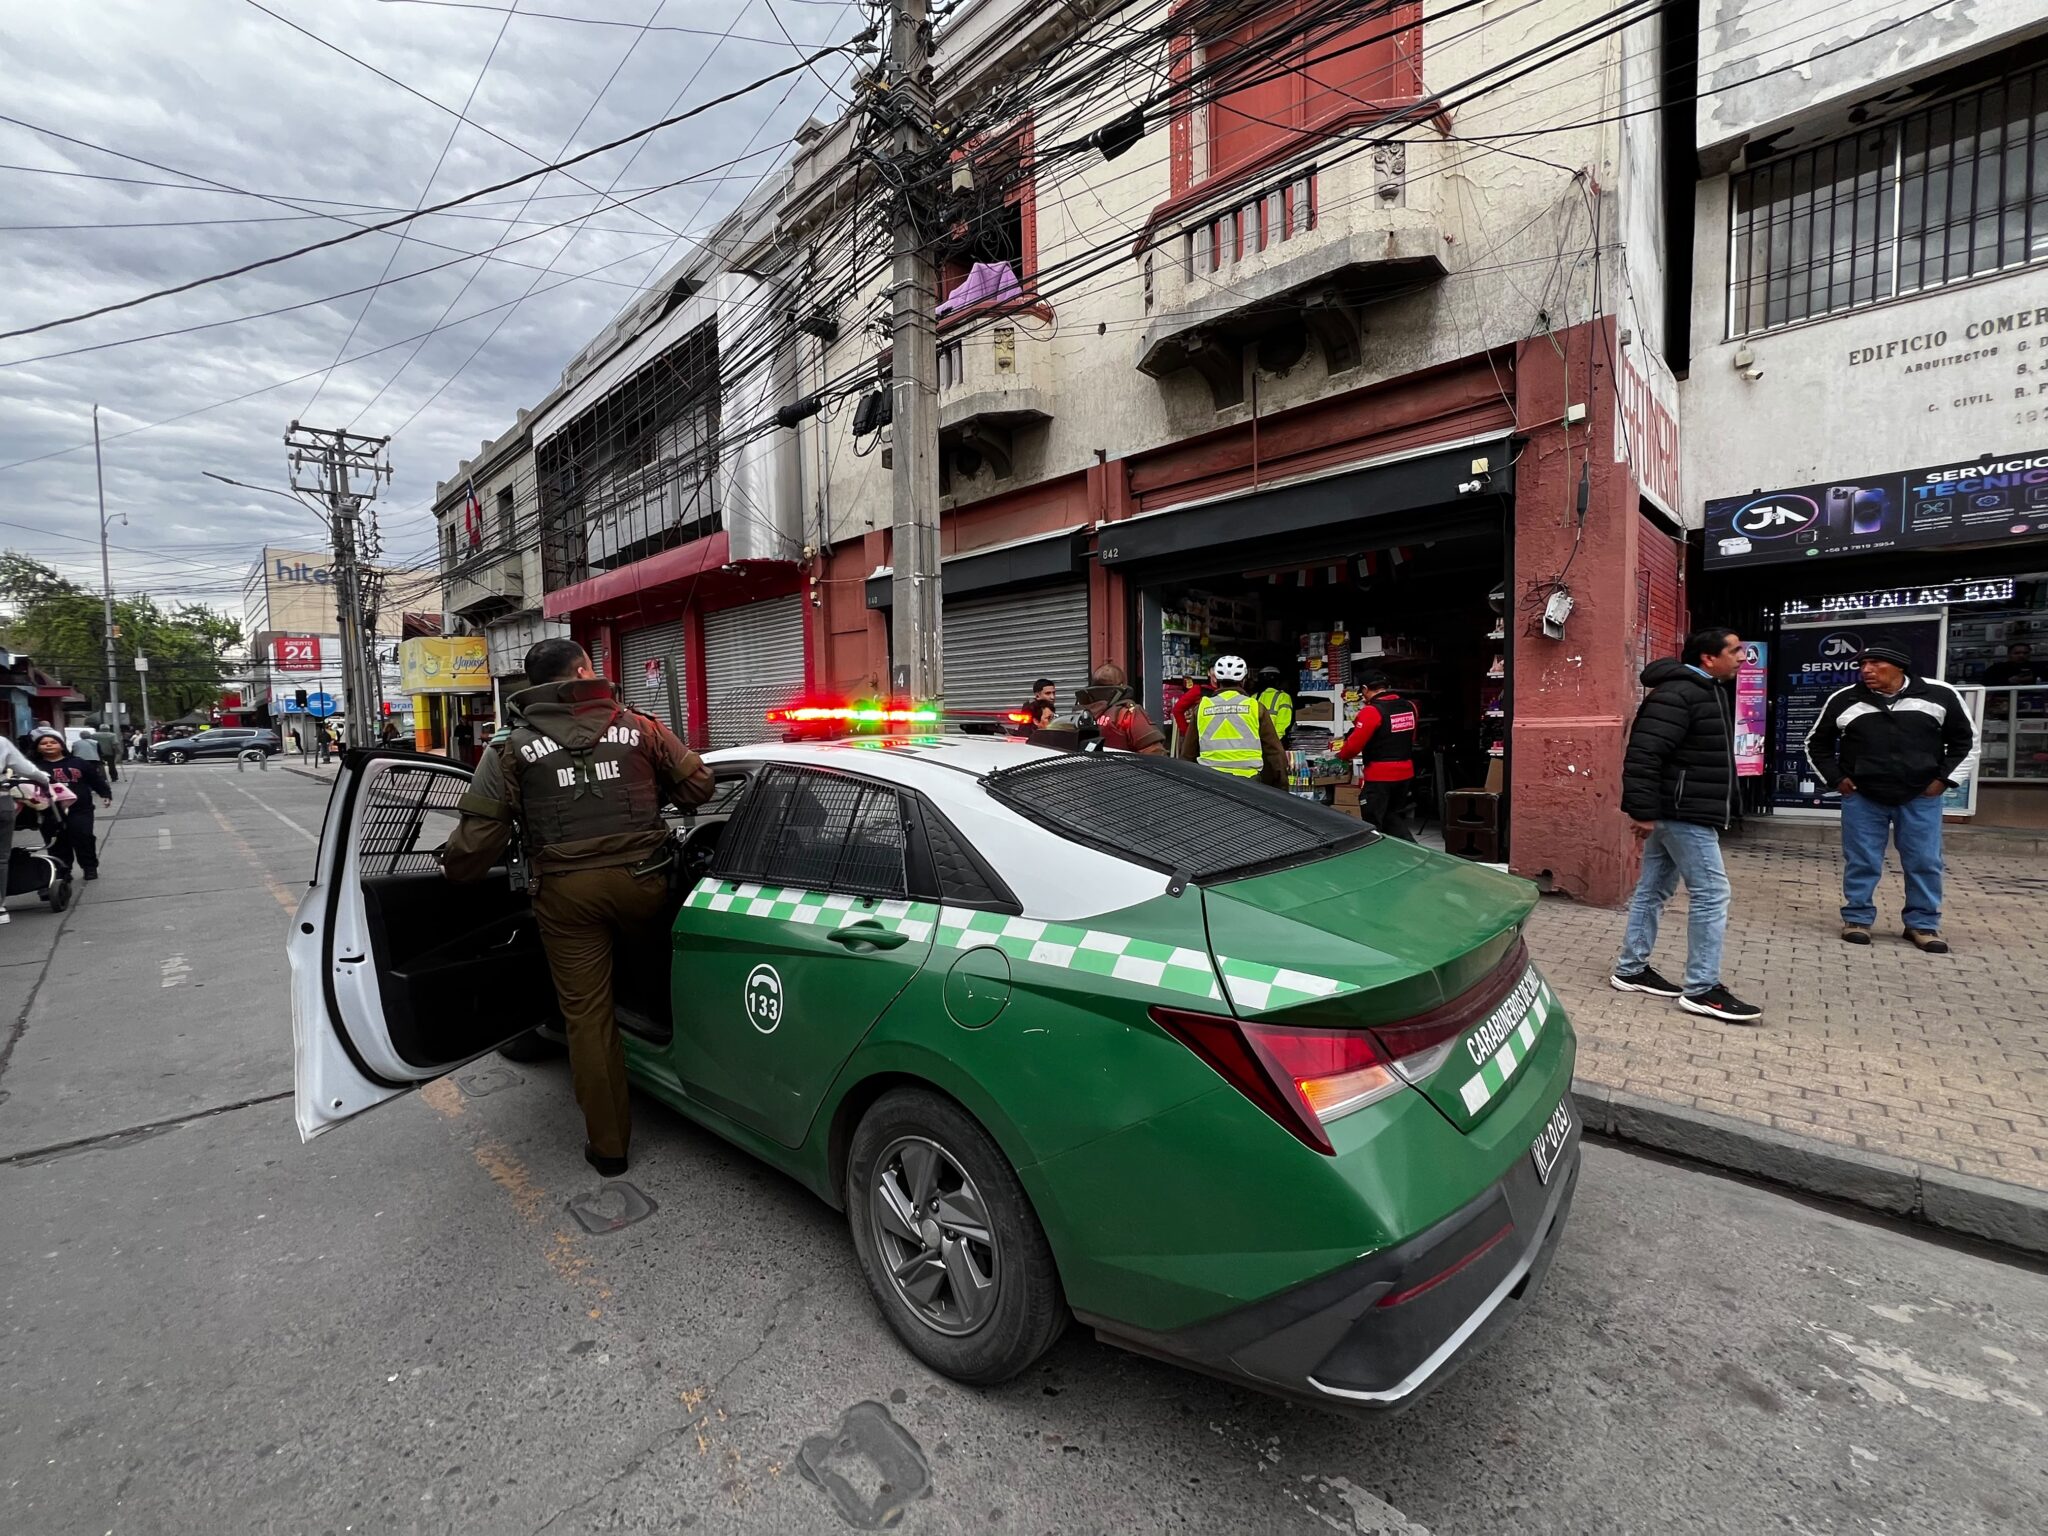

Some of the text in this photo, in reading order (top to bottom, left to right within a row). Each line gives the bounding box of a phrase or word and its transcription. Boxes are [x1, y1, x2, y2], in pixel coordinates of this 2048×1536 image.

[1849, 330, 1948, 366] EDIFICIO
[1904, 347, 1999, 374] ARQUITECTOS
[1953, 393, 1994, 408] CIVIL
[1102, 547, 1119, 560] 842
[285, 645, 314, 660] 24
[1801, 661, 1861, 672] SERVIC
[520, 725, 641, 763] CARROS
[53, 767, 82, 783] AP
[556, 767, 576, 787] DE
[749, 992, 778, 1020] 133
[1466, 989, 1527, 1066] CARABINEROS
